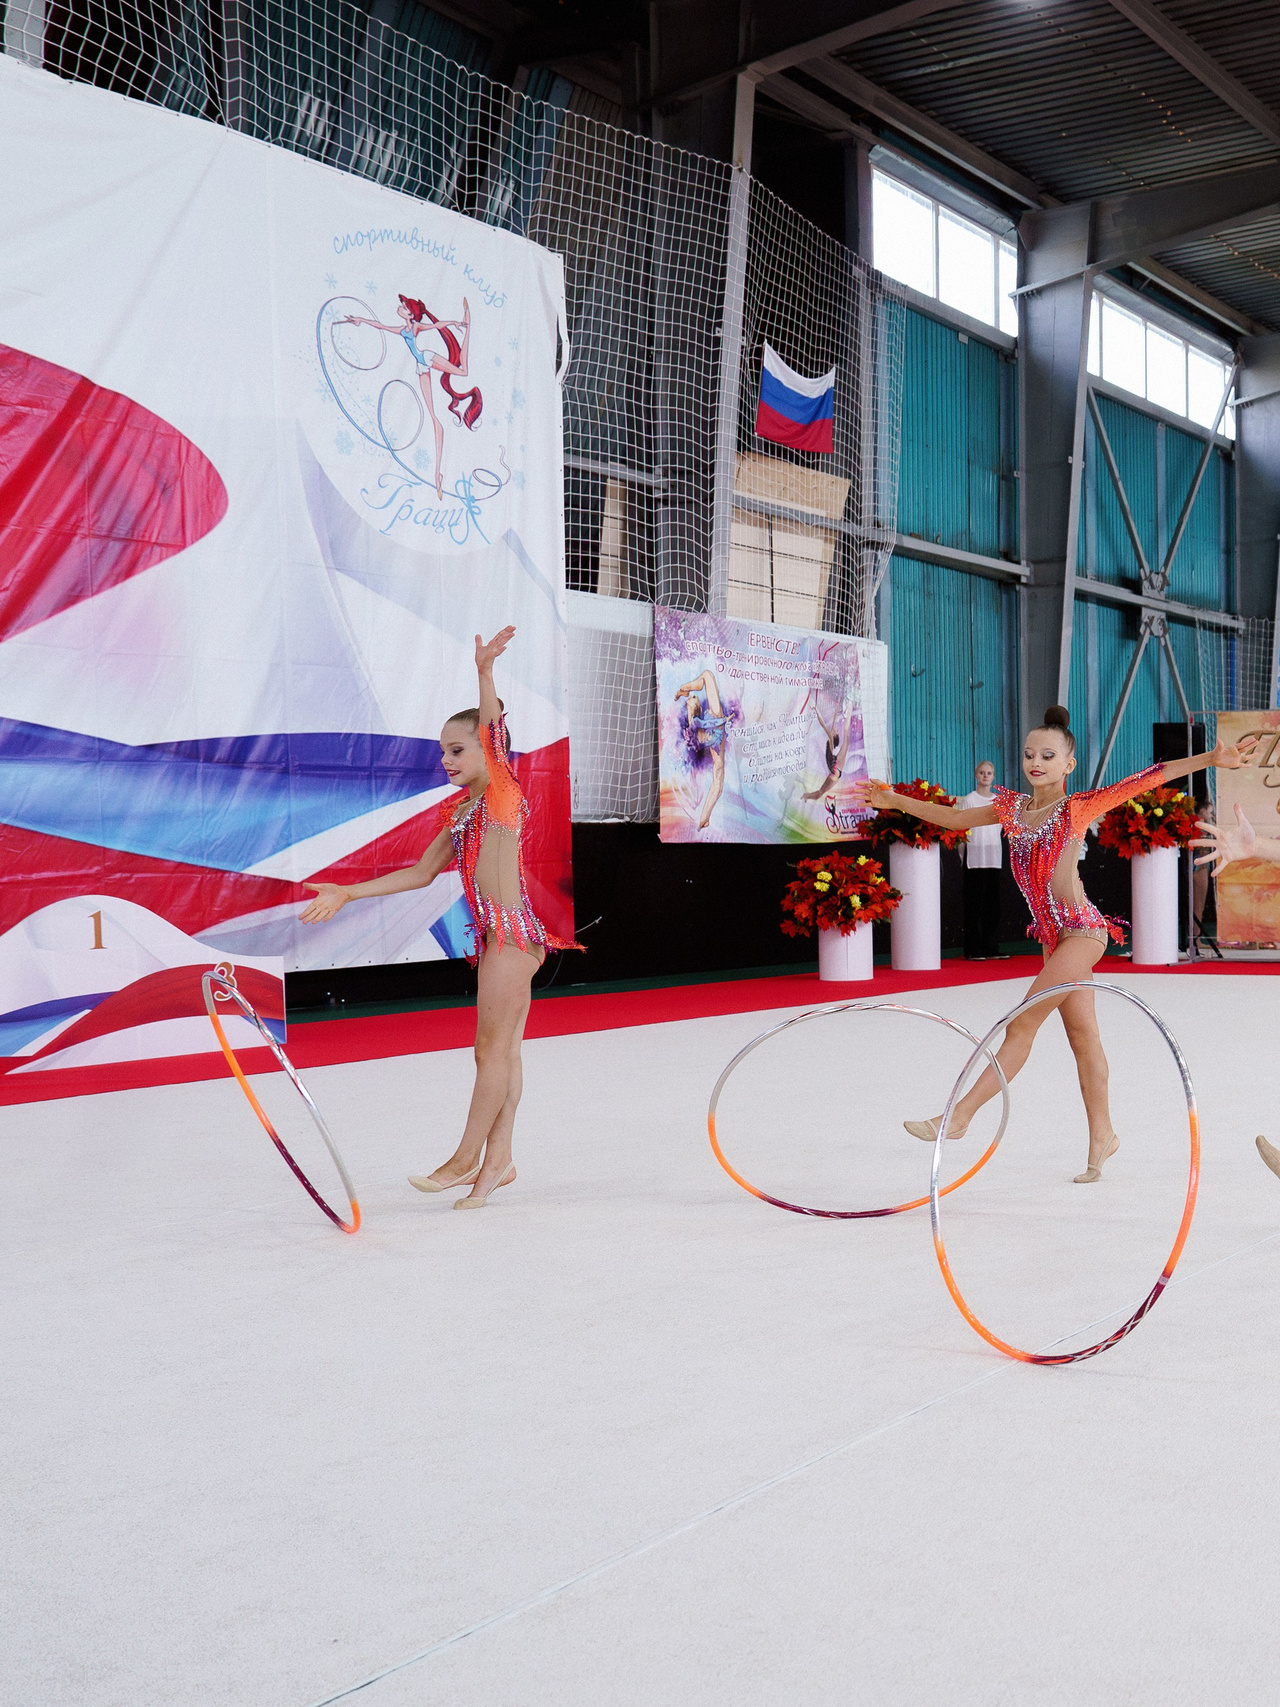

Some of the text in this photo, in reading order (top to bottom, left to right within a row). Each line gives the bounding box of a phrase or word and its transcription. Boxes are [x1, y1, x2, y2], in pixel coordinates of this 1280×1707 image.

[332, 226, 508, 309] спортивный клуб
[88, 910, 108, 951] 1
[213, 961, 238, 1002] 3
